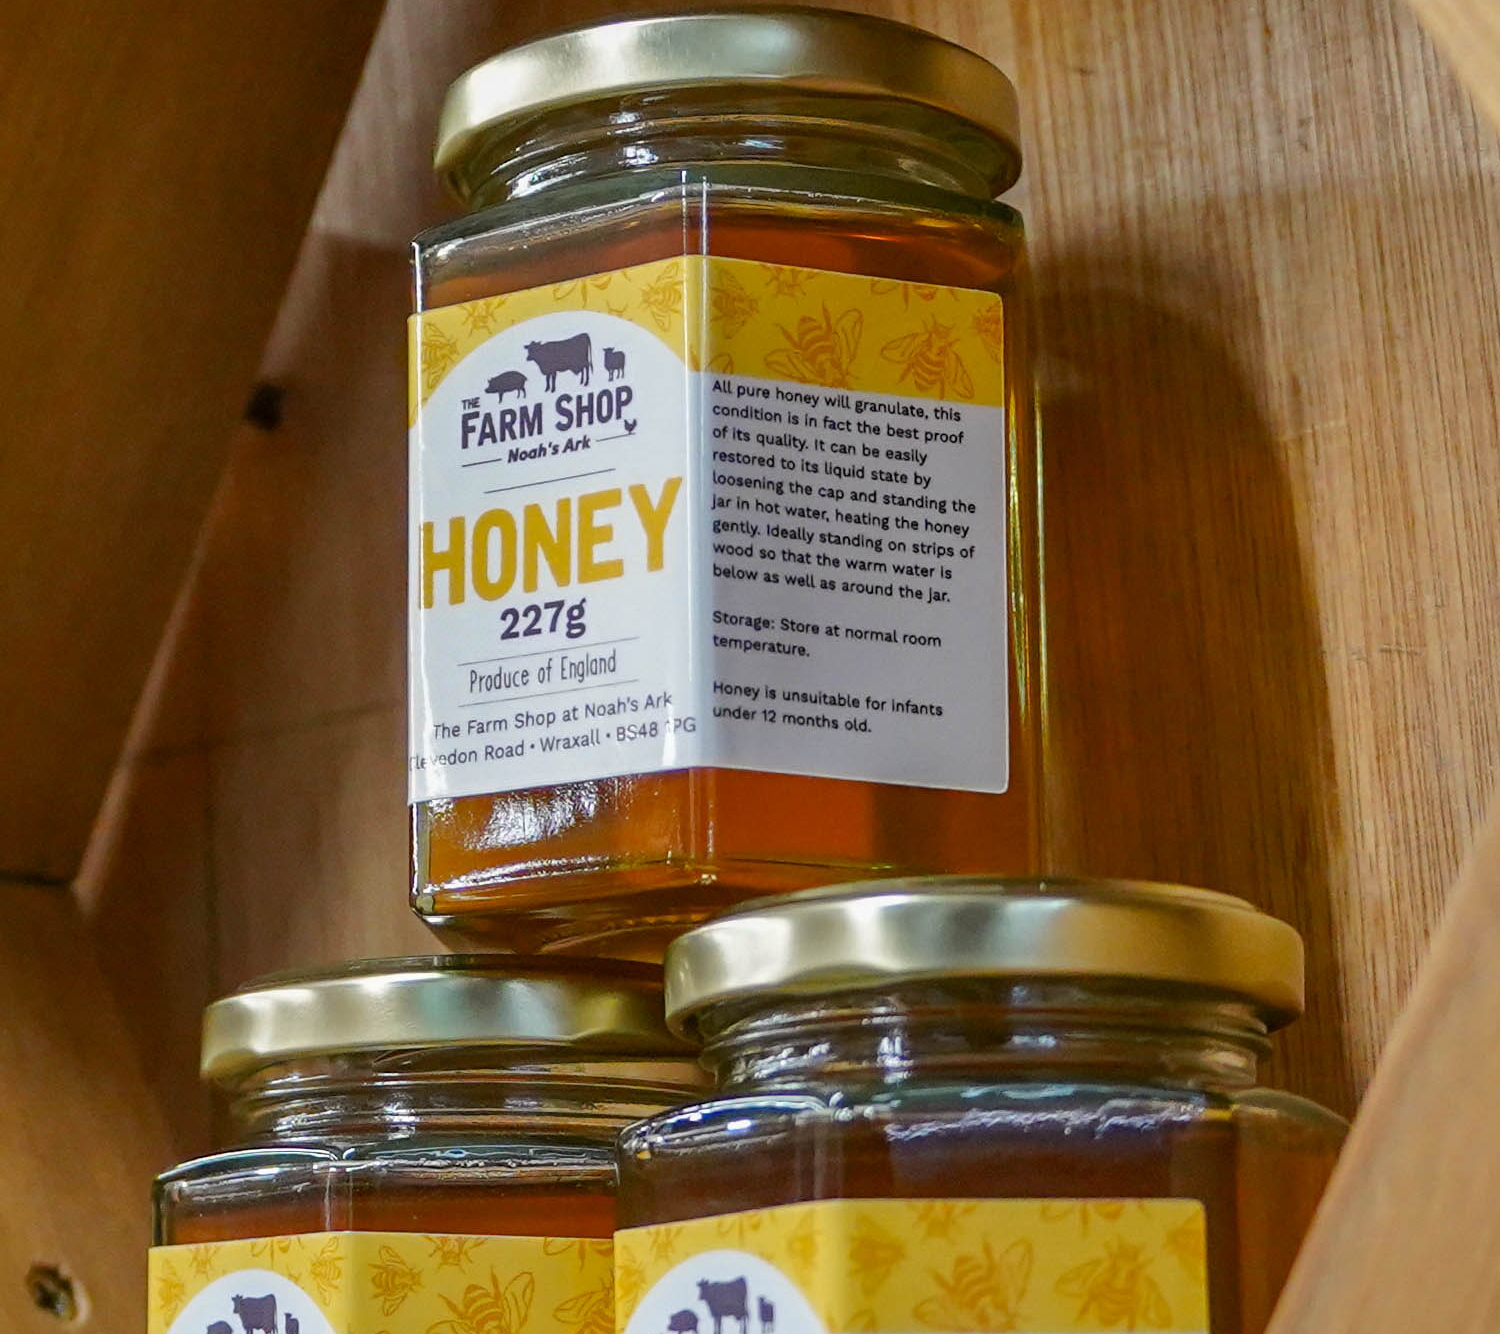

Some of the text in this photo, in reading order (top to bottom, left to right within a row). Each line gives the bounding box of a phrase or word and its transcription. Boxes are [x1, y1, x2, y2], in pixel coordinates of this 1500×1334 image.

[461, 385, 634, 449] FARM SHOP
[462, 397, 480, 409] THE
[712, 379, 961, 422] All pure honey will granulate, this
[713, 405, 964, 443] condition is in fact the best proof
[508, 436, 590, 463] Noah's Ark
[713, 425, 927, 466] of its quality. It can be easily
[713, 451, 931, 489] restored to its liquid state by
[713, 471, 976, 514] loosening the cap and standing the
[711, 494, 969, 539] jar in hot water, heating the honey
[418, 476, 683, 609] HONEY
[713, 520, 975, 559] gently. Ideally standing on strips of
[713, 544, 952, 579] wood so that the warm water is
[713, 563, 950, 603] below as well as around the jar.
[500, 598, 587, 640] 227g
[713, 611, 941, 647] Storage: Store at normal room
[713, 635, 810, 657] temperature.
[470, 649, 617, 693] Produce of England
[434, 692, 672, 739] The Farm Shop at Noah's Ark
[714, 681, 943, 717] Honey is unsuitable for infants
[713, 707, 872, 733] under 12 months old.
[485, 742, 523, 761] Road
[540, 730, 600, 752] Wraxall
[617, 721, 657, 742] BS48
